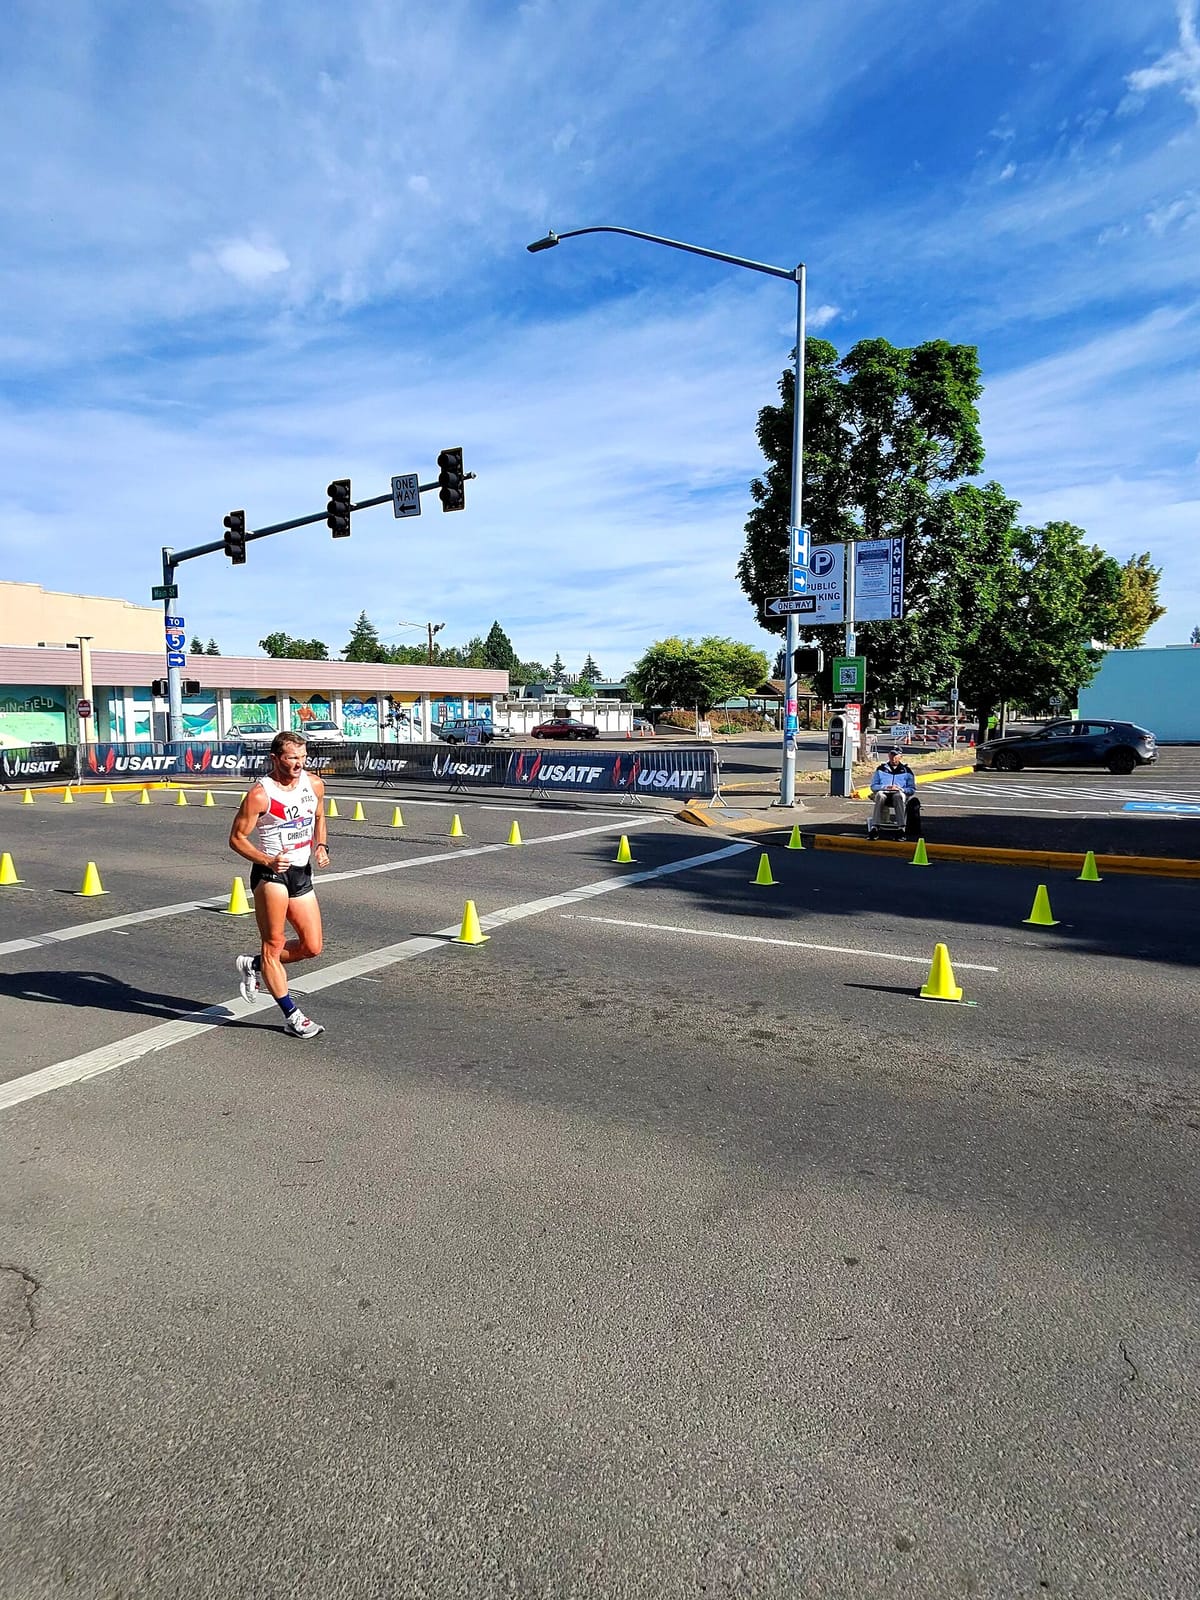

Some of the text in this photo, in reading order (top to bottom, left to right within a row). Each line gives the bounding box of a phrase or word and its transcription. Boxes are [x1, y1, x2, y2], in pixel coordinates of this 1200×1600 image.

[395, 478, 414, 490] ONE
[396, 489, 416, 502] WAY
[794, 529, 808, 567] H
[815, 553, 831, 574] P
[892, 538, 902, 603] PAY HERE
[806, 581, 837, 591] PUBLIC
[816, 592, 841, 601] KING
[778, 600, 812, 610] ONE WAY
[169, 618, 180, 626] TO
[171, 634, 180, 647] 5
[20, 760, 61, 774] USATF
[115, 755, 178, 771] USATF
[211, 754, 267, 769] USATF
[304, 756, 332, 768] SATF
[368, 758, 409, 772] USATF
[448, 762, 494, 777] USATF
[537, 765, 605, 784] USATF
[637, 769, 706, 789] USATF
[286, 805, 300, 820] 12
[287, 828, 309, 841] CHRISTIE
